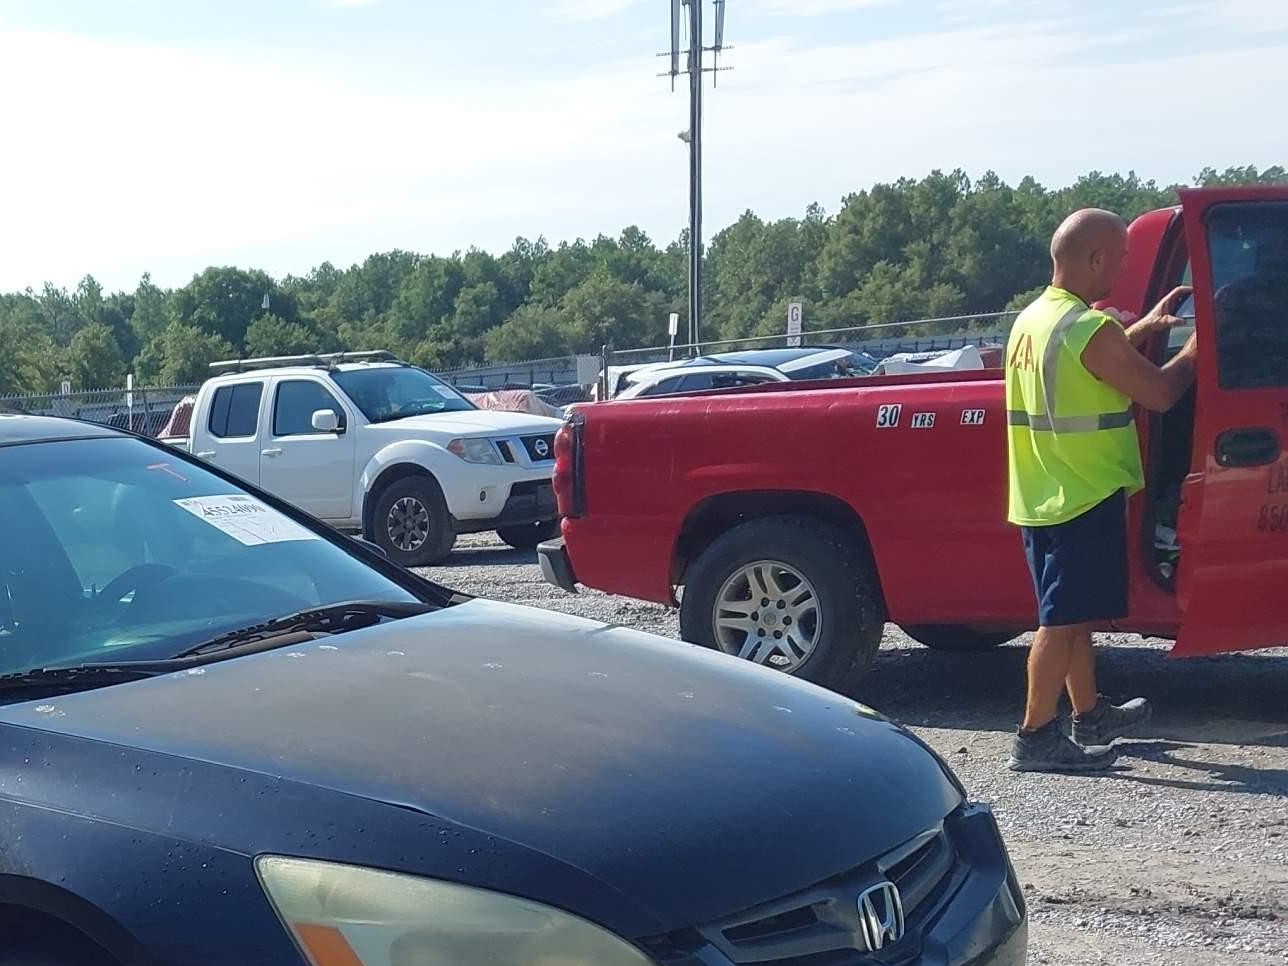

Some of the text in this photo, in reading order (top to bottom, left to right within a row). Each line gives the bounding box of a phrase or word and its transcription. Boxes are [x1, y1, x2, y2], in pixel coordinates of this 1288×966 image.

[791, 306, 800, 321] G
[878, 405, 984, 427] 30 YRS EXP
